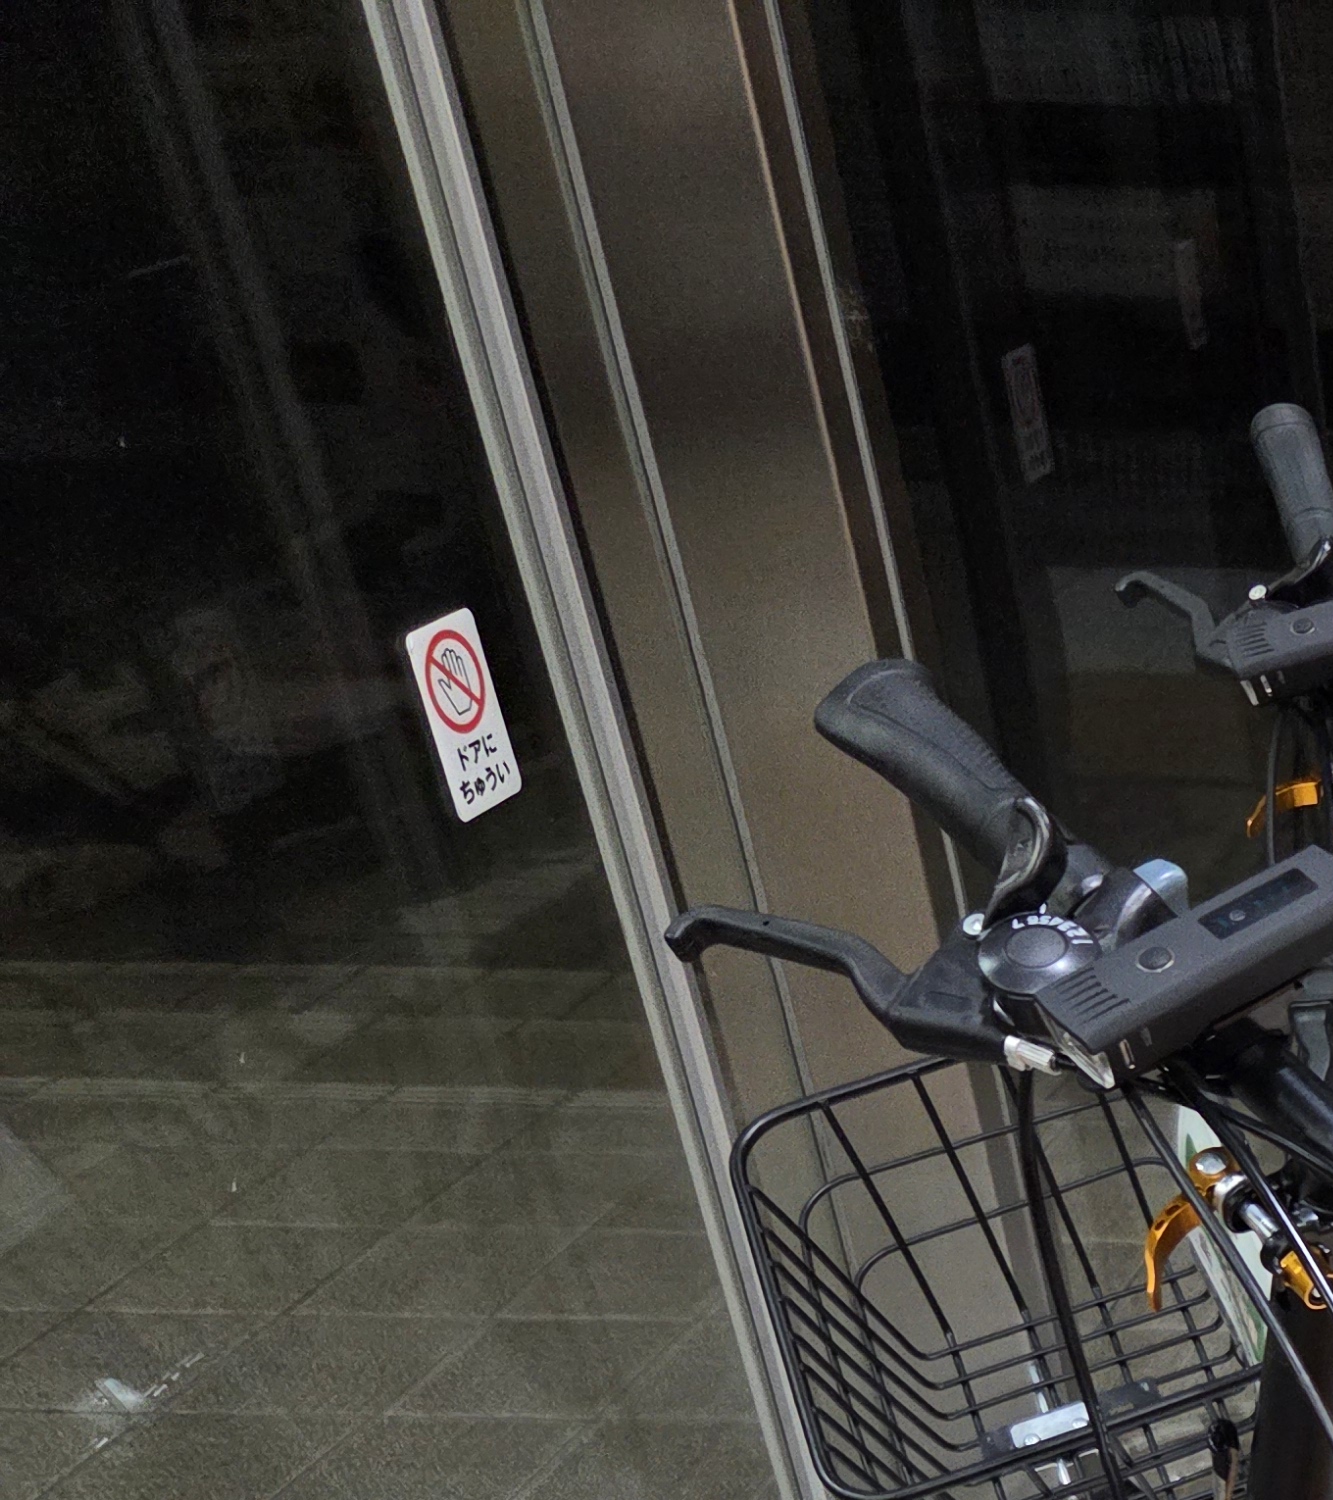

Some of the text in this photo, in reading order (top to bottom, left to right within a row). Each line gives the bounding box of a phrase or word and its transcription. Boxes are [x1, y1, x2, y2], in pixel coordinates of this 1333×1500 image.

[456, 733, 498, 771] ドアに
[459, 760, 511, 805] ちゅうい
